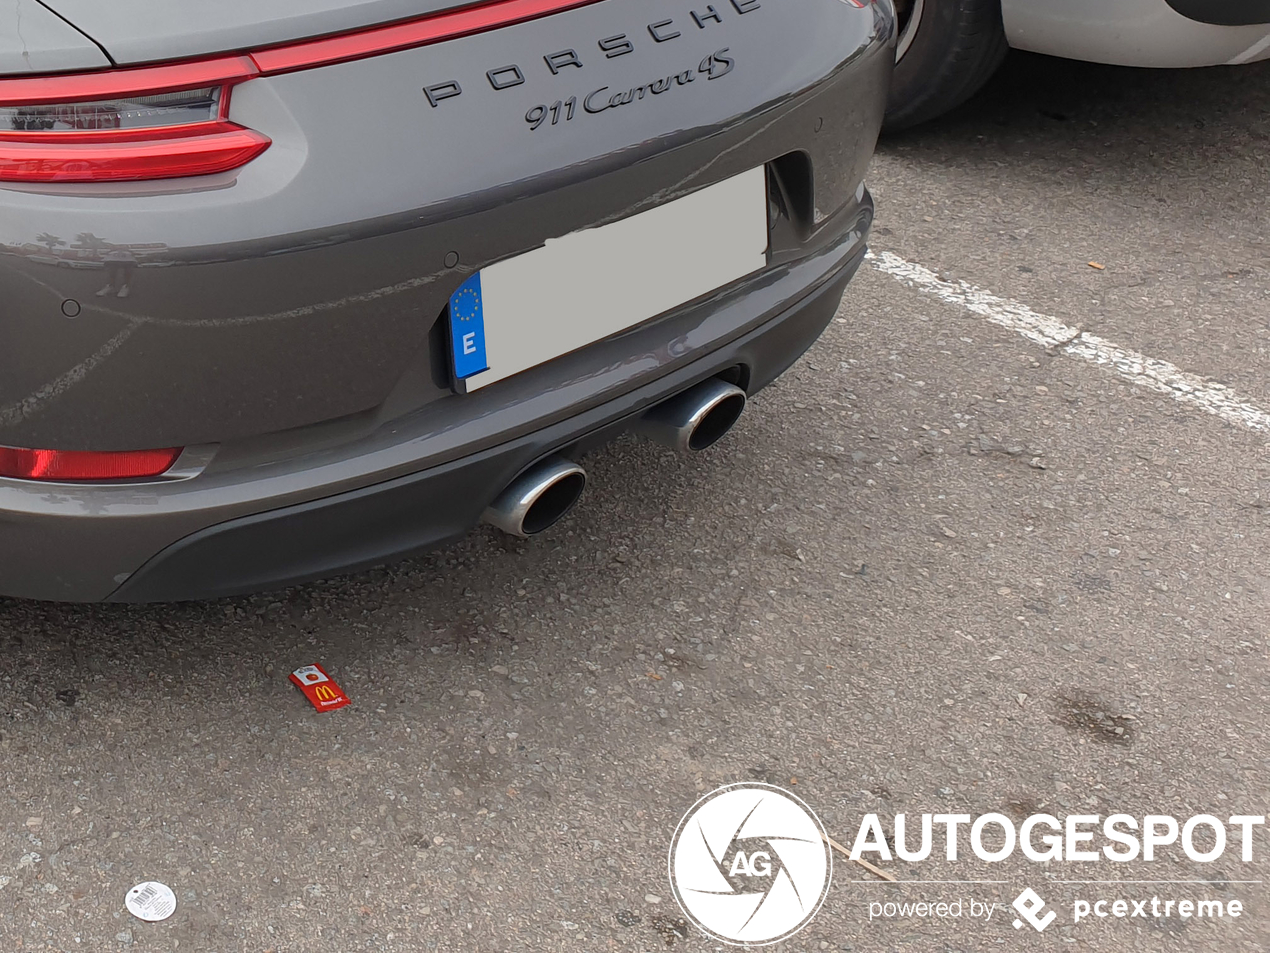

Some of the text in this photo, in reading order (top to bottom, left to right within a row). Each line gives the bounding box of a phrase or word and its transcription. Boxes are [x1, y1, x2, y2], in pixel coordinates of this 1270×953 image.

[524, 47, 735, 131] 911 Carrera 4S
[462, 331, 477, 355] E
